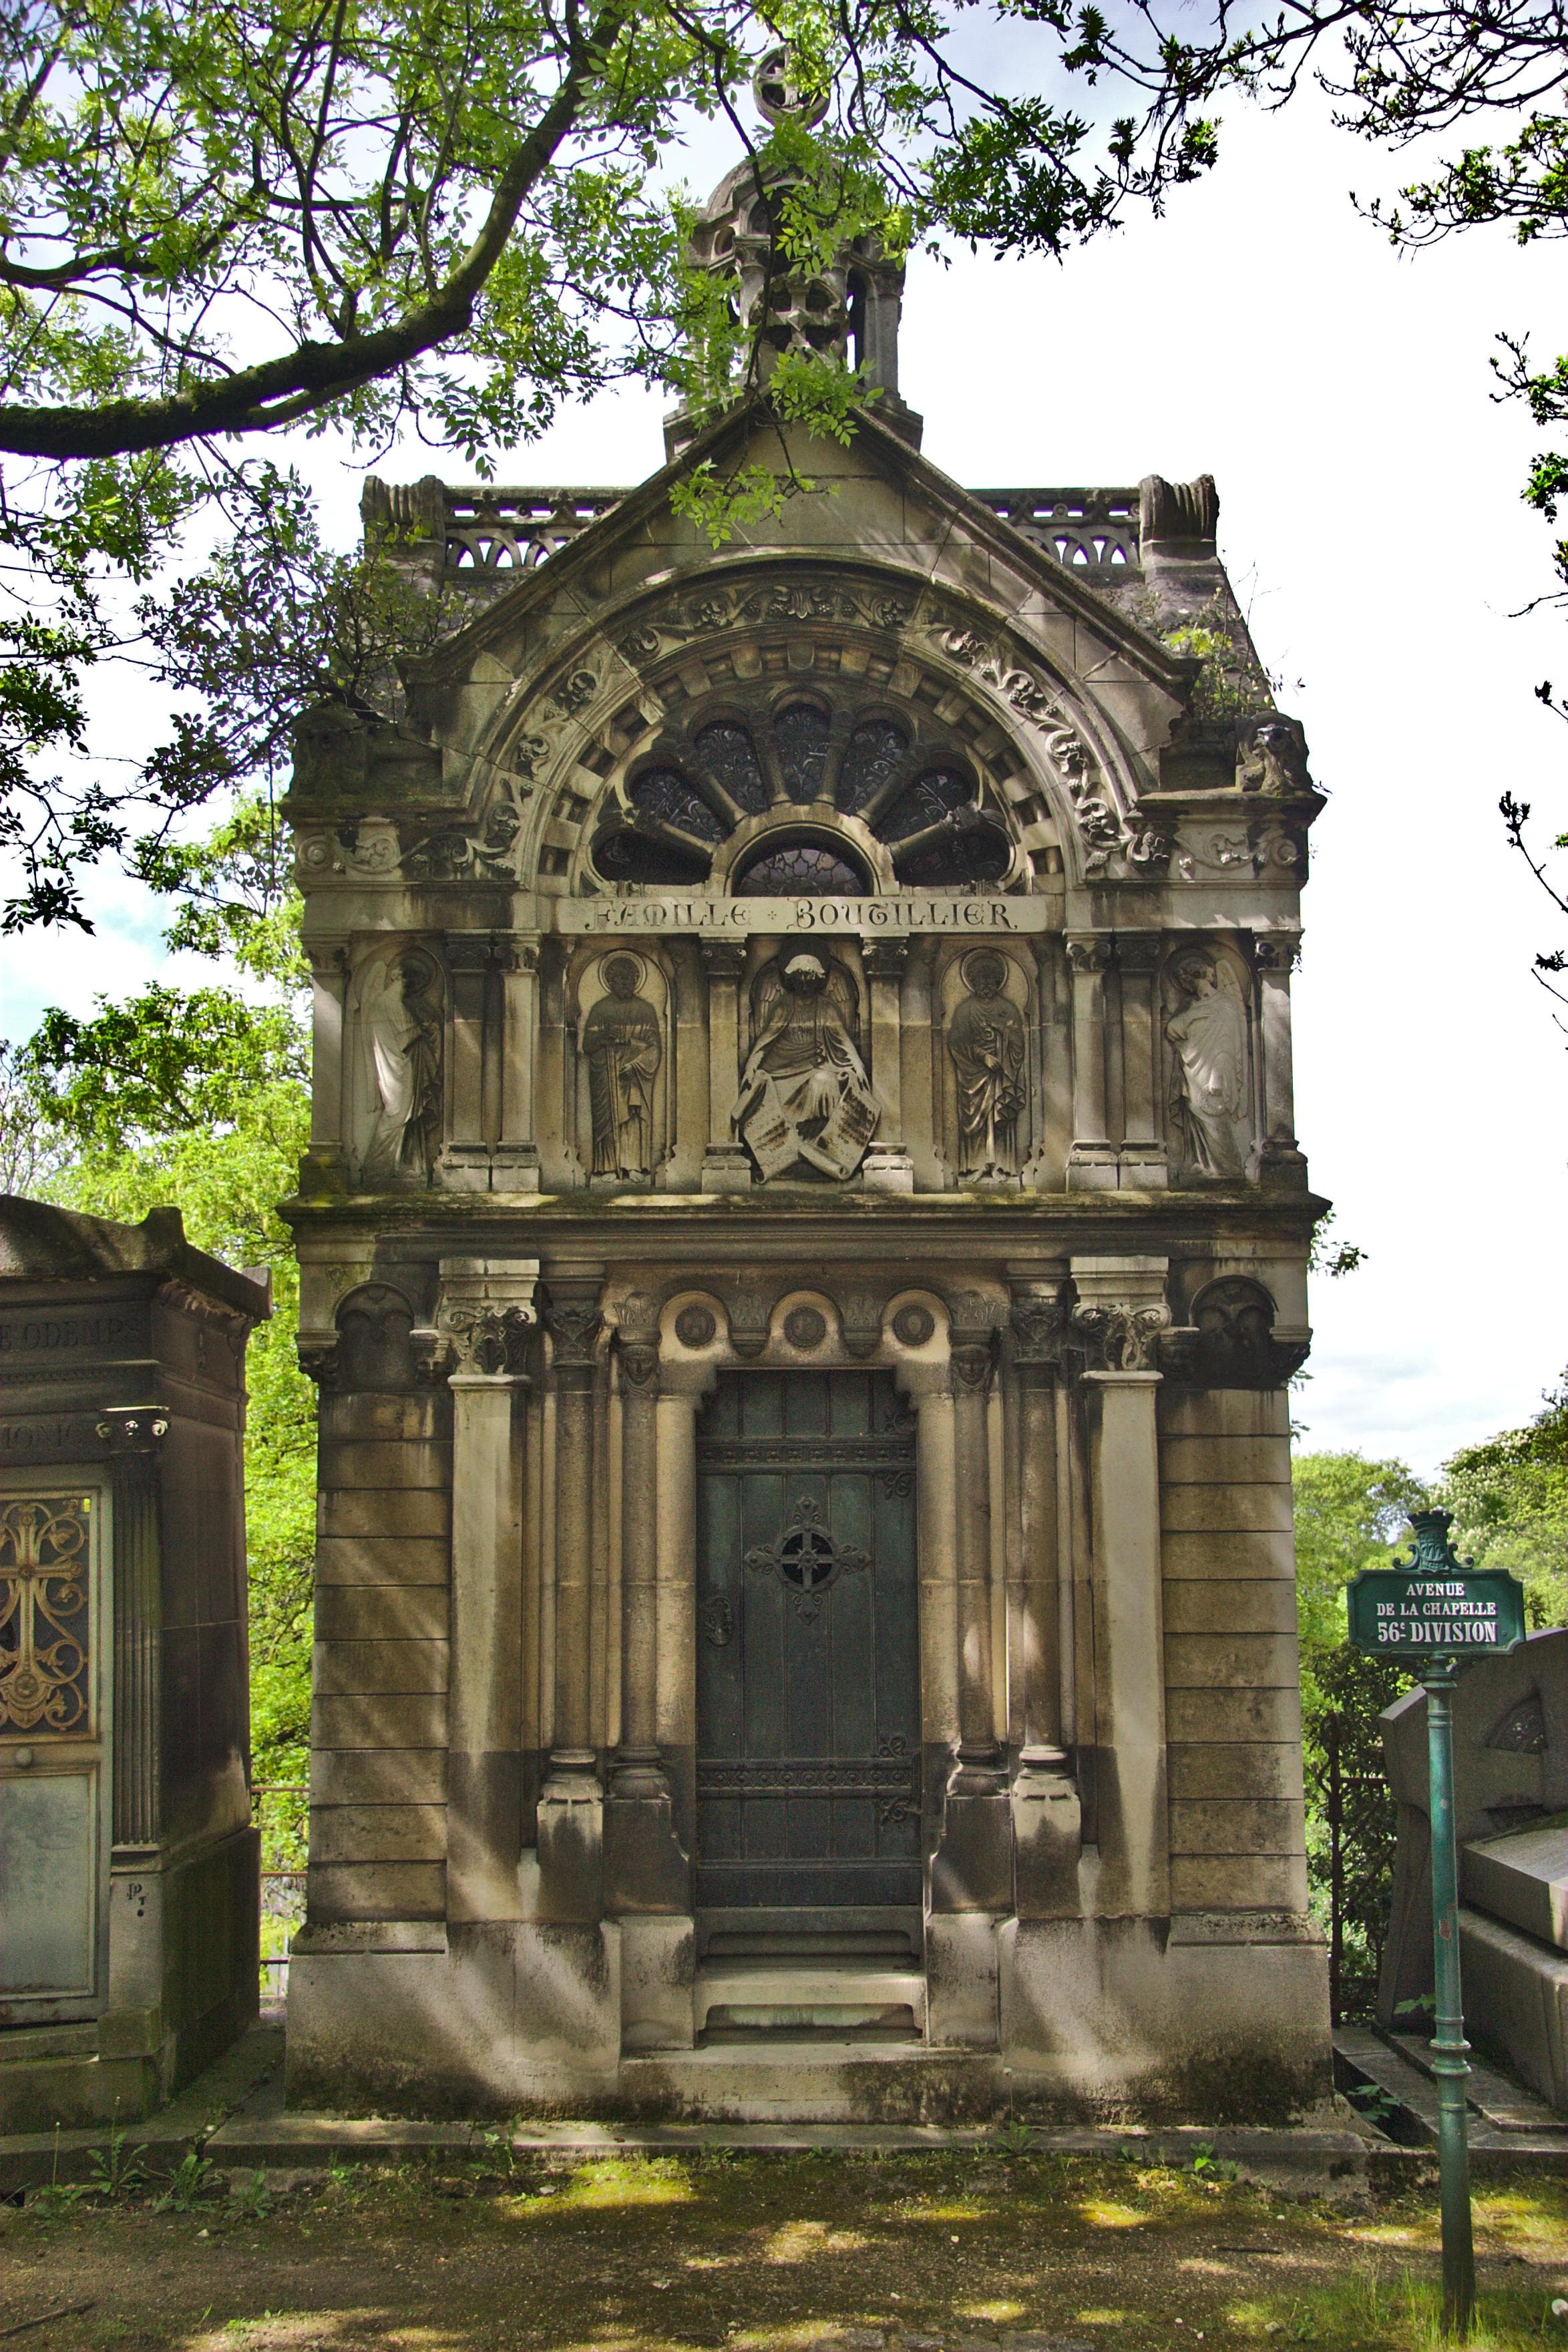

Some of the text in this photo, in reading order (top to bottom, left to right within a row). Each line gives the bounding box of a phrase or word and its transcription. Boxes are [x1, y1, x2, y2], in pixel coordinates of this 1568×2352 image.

[584, 898, 1018, 931] FAMILLE BOUTILLIER
[1406, 1583, 1465, 1597] AVENUE
[1376, 1602, 1496, 1616] DE LA CHAPELLE
[1410, 1621, 1497, 1643] DIVISION
